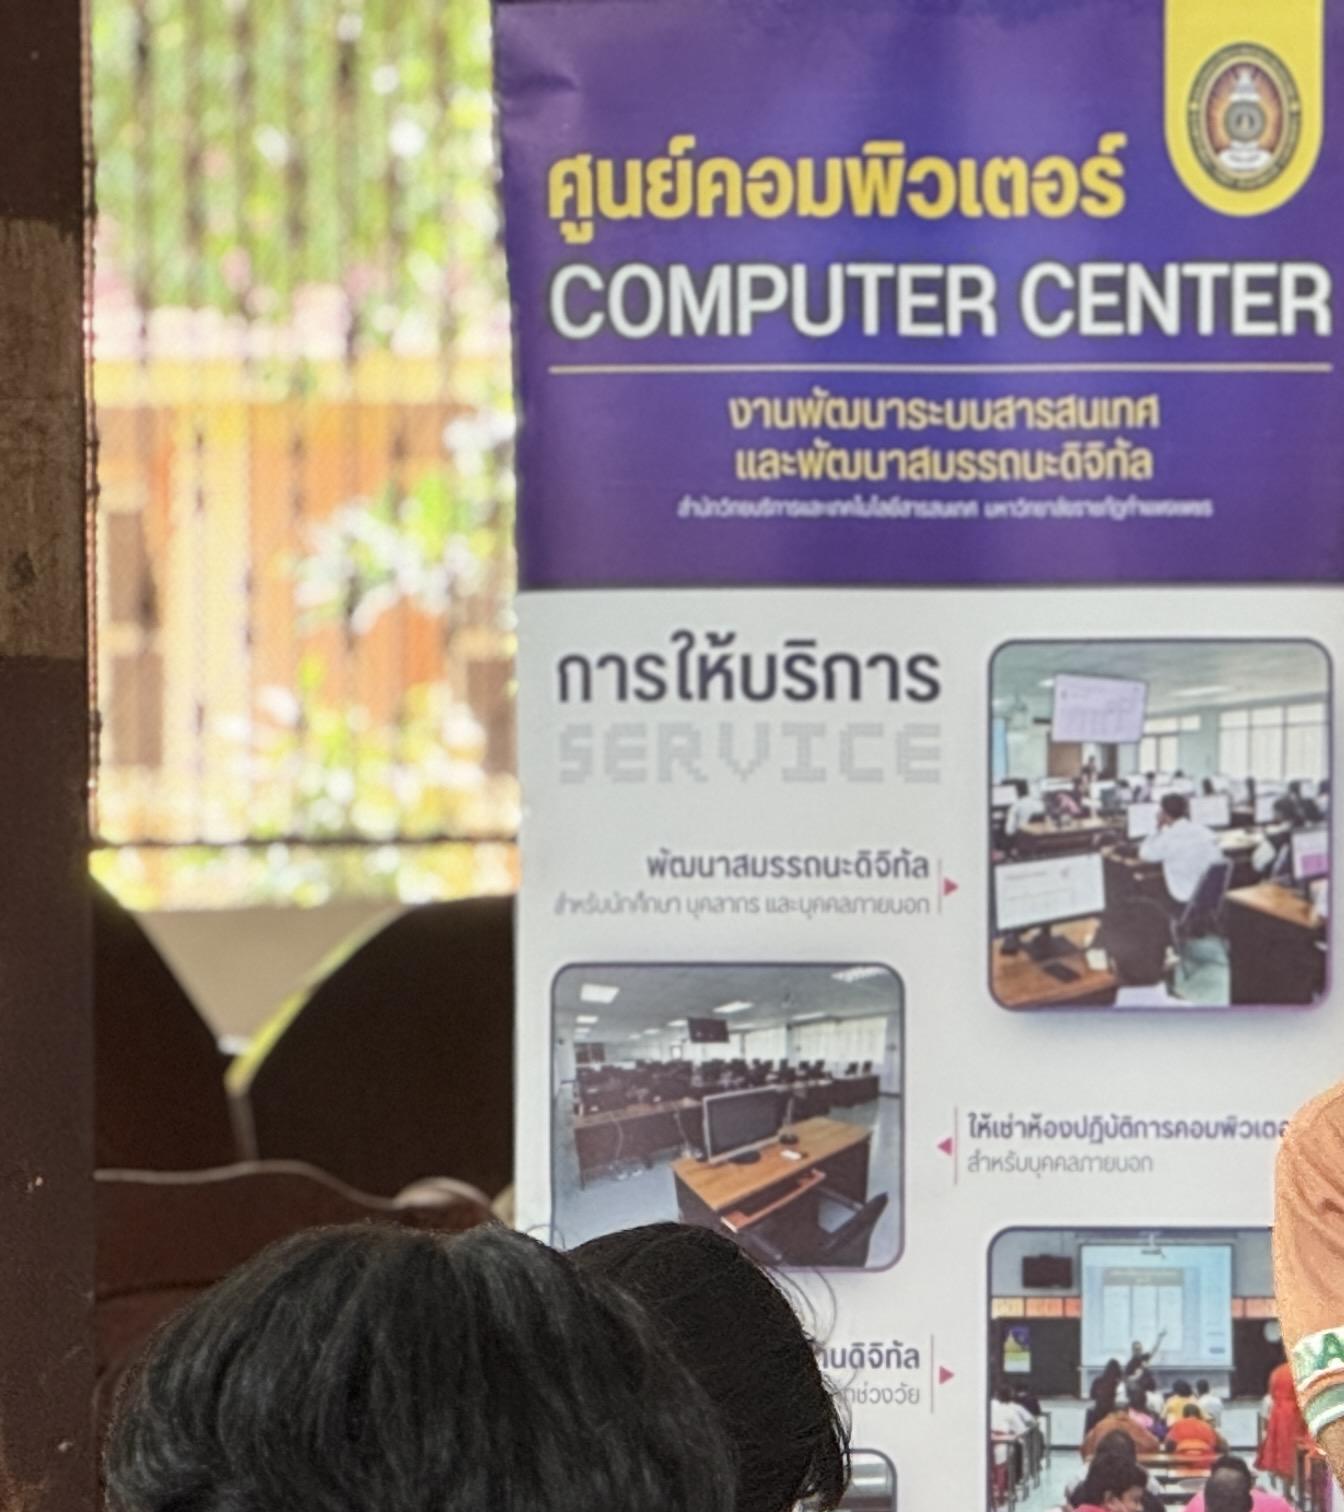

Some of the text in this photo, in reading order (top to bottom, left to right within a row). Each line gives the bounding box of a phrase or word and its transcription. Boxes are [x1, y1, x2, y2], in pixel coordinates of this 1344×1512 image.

[549, 134, 1127, 244] ศูนย์คอมพิวเตอร์
[549, 263, 1333, 339] COMPUTER CENTER
[729, 387, 1160, 431] งานพัฒนาระบบสารสนเทศ
[736, 438, 1153, 482] และพัฒนาสมรรถนะดิจิทัล
[557, 629, 941, 703] การให้บริการ
[559, 721, 941, 785] SERVICE
[647, 848, 930, 880] พัฒนาสมรรถนะดิจิทัล
[967, 1149, 1154, 1178] สำหรับบุคคลภายนอก
